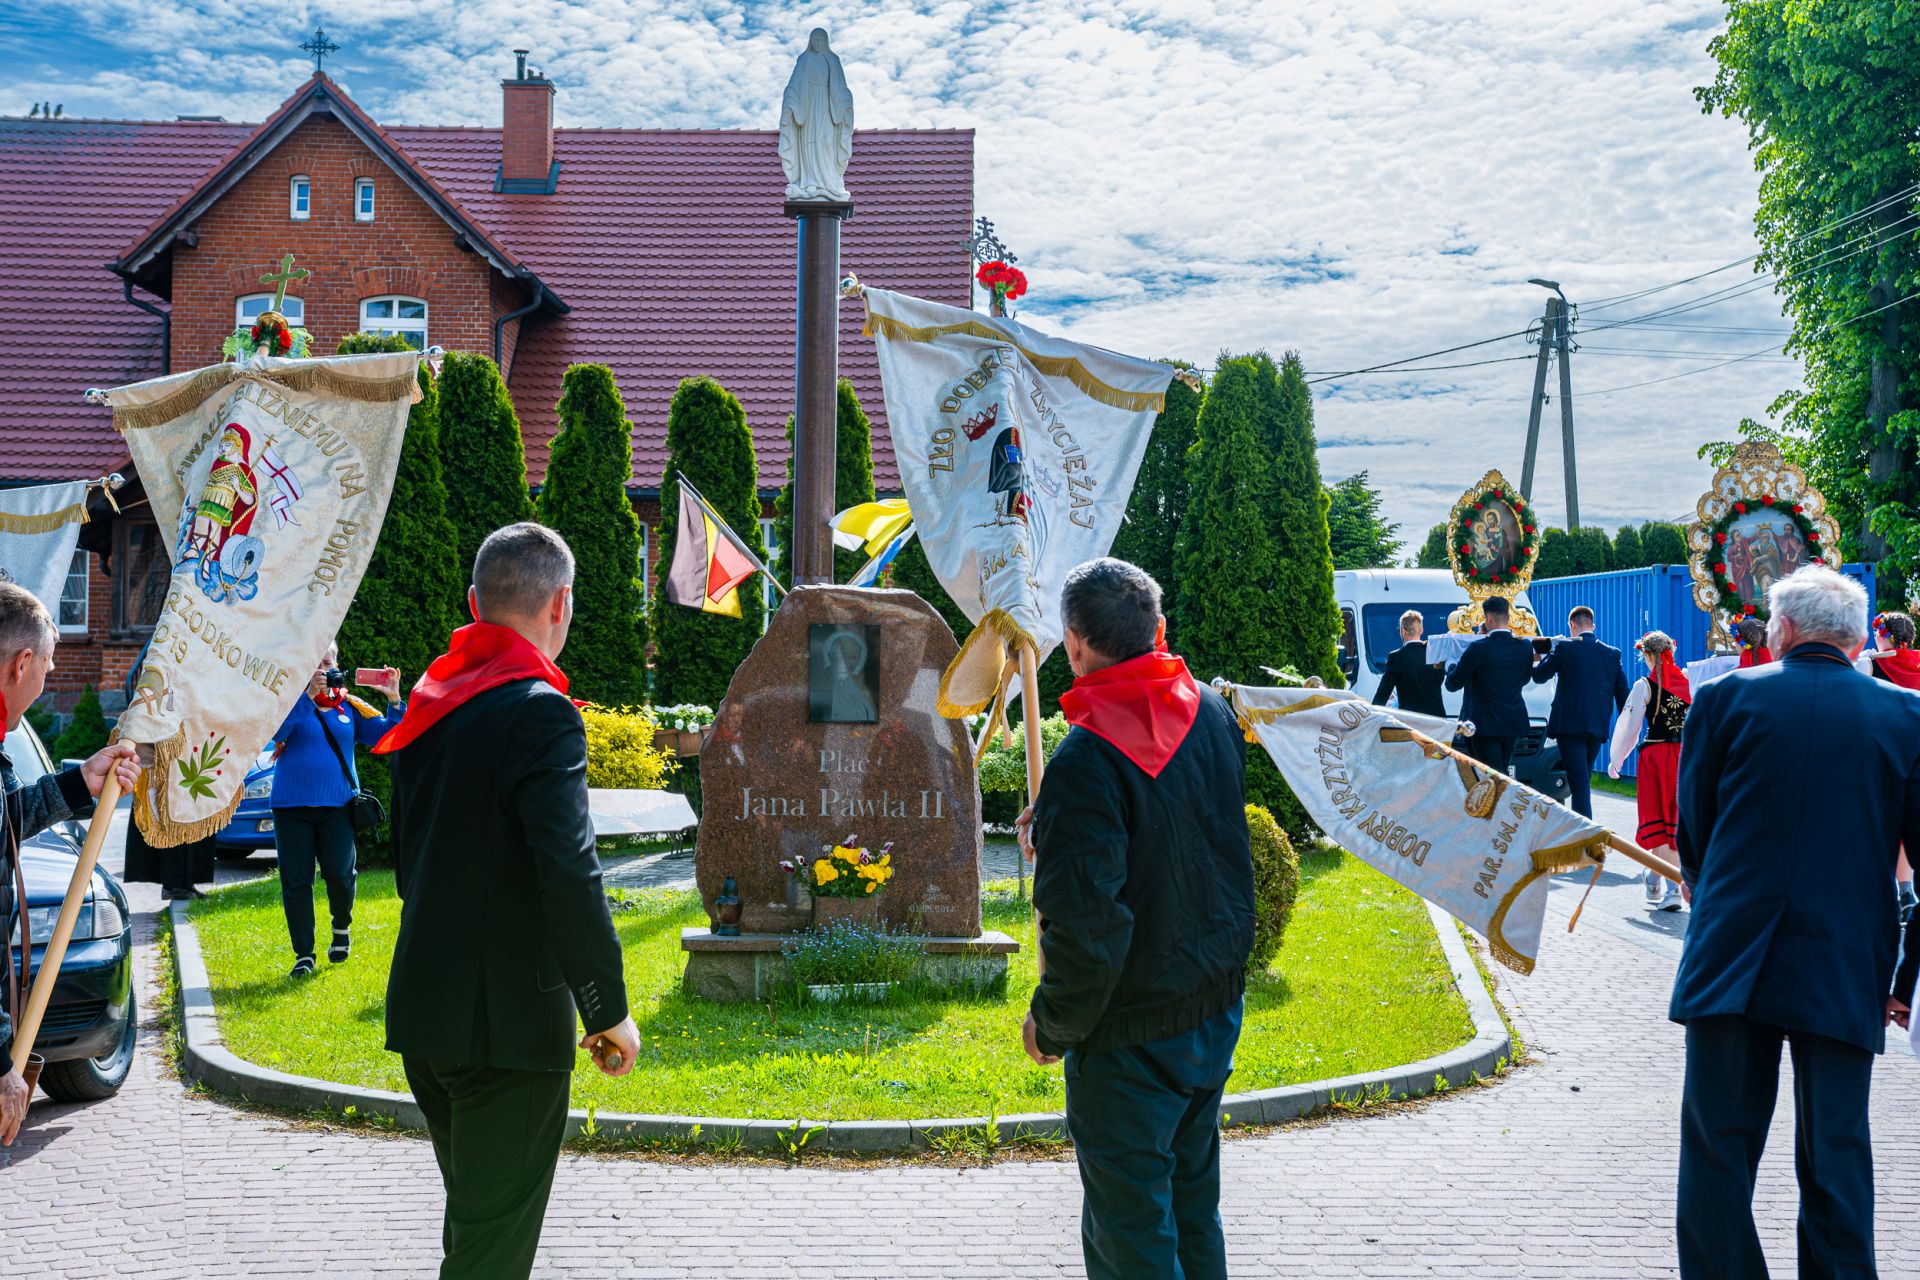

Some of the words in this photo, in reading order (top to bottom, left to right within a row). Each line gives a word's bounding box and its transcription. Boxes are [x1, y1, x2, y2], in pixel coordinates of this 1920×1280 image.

[336, 462, 365, 500] NA
[929, 428, 956, 479] ZŁO
[1030, 379, 1097, 529] ZWYCIĘŻAJ
[308, 519, 360, 596] POMOC
[819, 749, 869, 773] Plac
[1314, 726, 1367, 820] KRZYŻU
[734, 787, 807, 821] Jana
[818, 787, 907, 818] Pawła
[918, 789, 946, 819] II
[1357, 810, 1432, 867] DOBRY
[1473, 856, 1504, 900] PAR.
[1492, 821, 1519, 855] ŚW.
